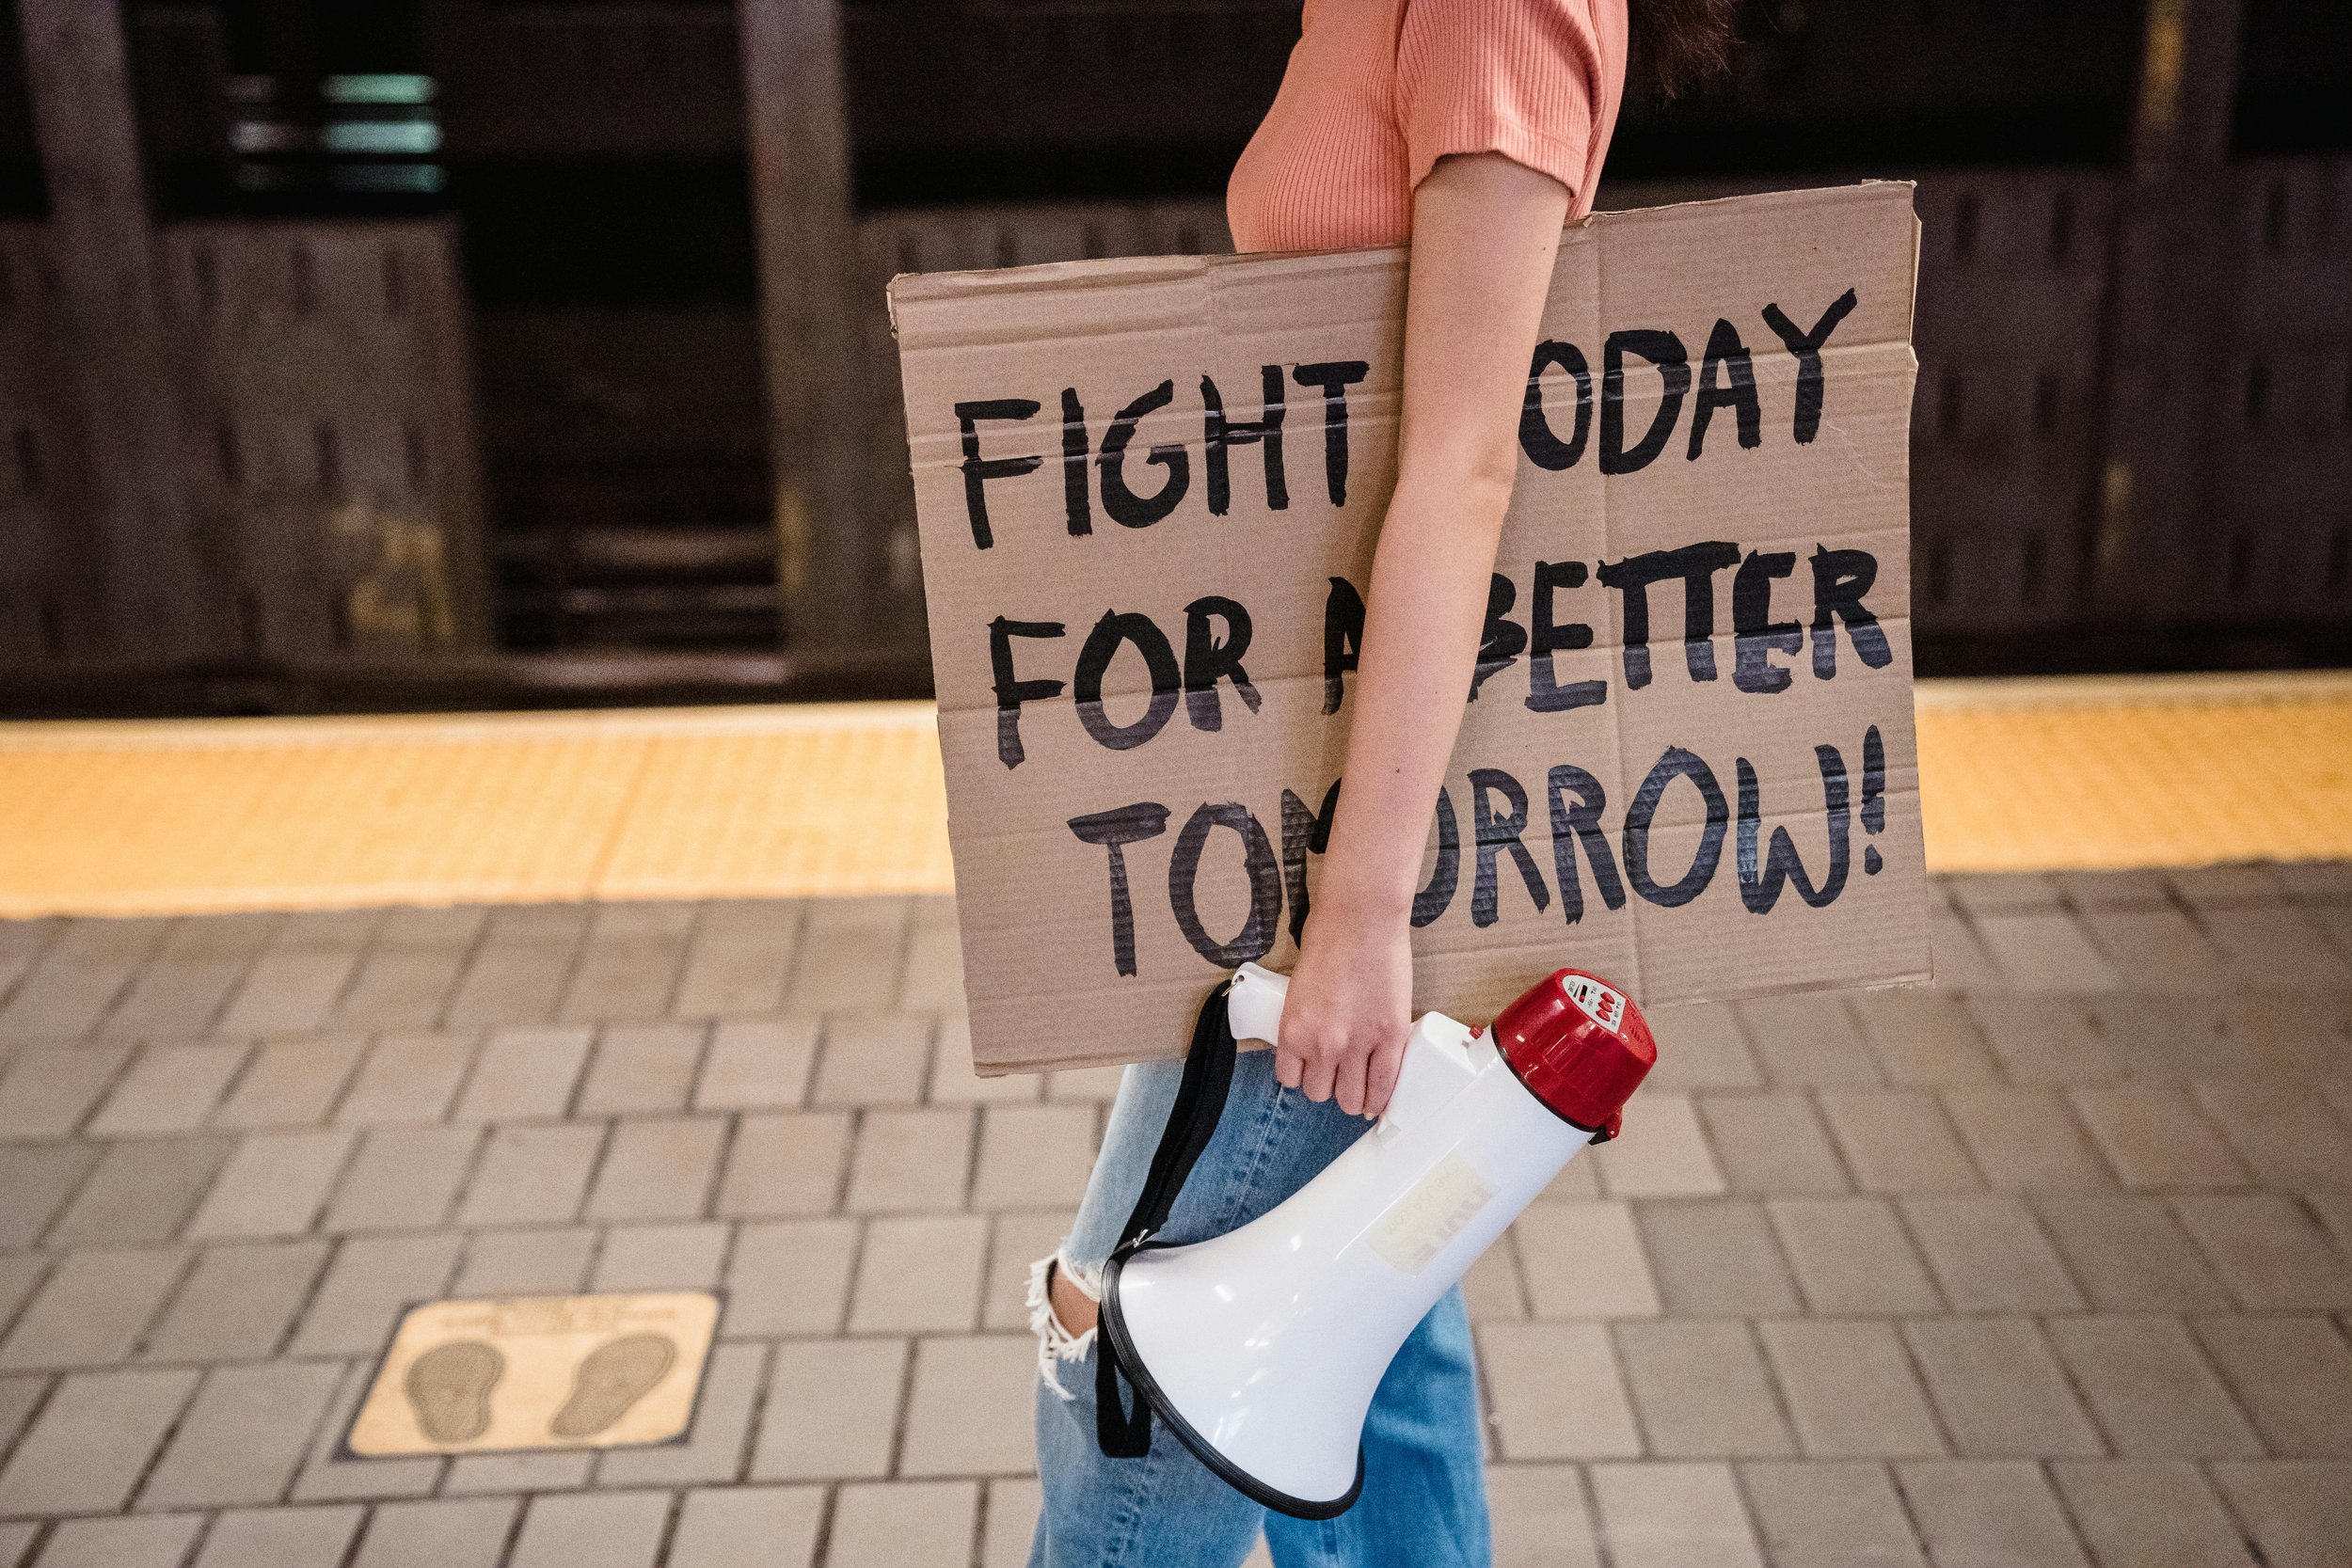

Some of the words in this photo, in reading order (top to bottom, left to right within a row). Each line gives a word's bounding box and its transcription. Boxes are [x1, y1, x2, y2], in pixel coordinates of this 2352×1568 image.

[954, 359, 1371, 550] FIGHT
[1518, 288, 1858, 475] ODAY
[988, 595, 1263, 770] FOR
